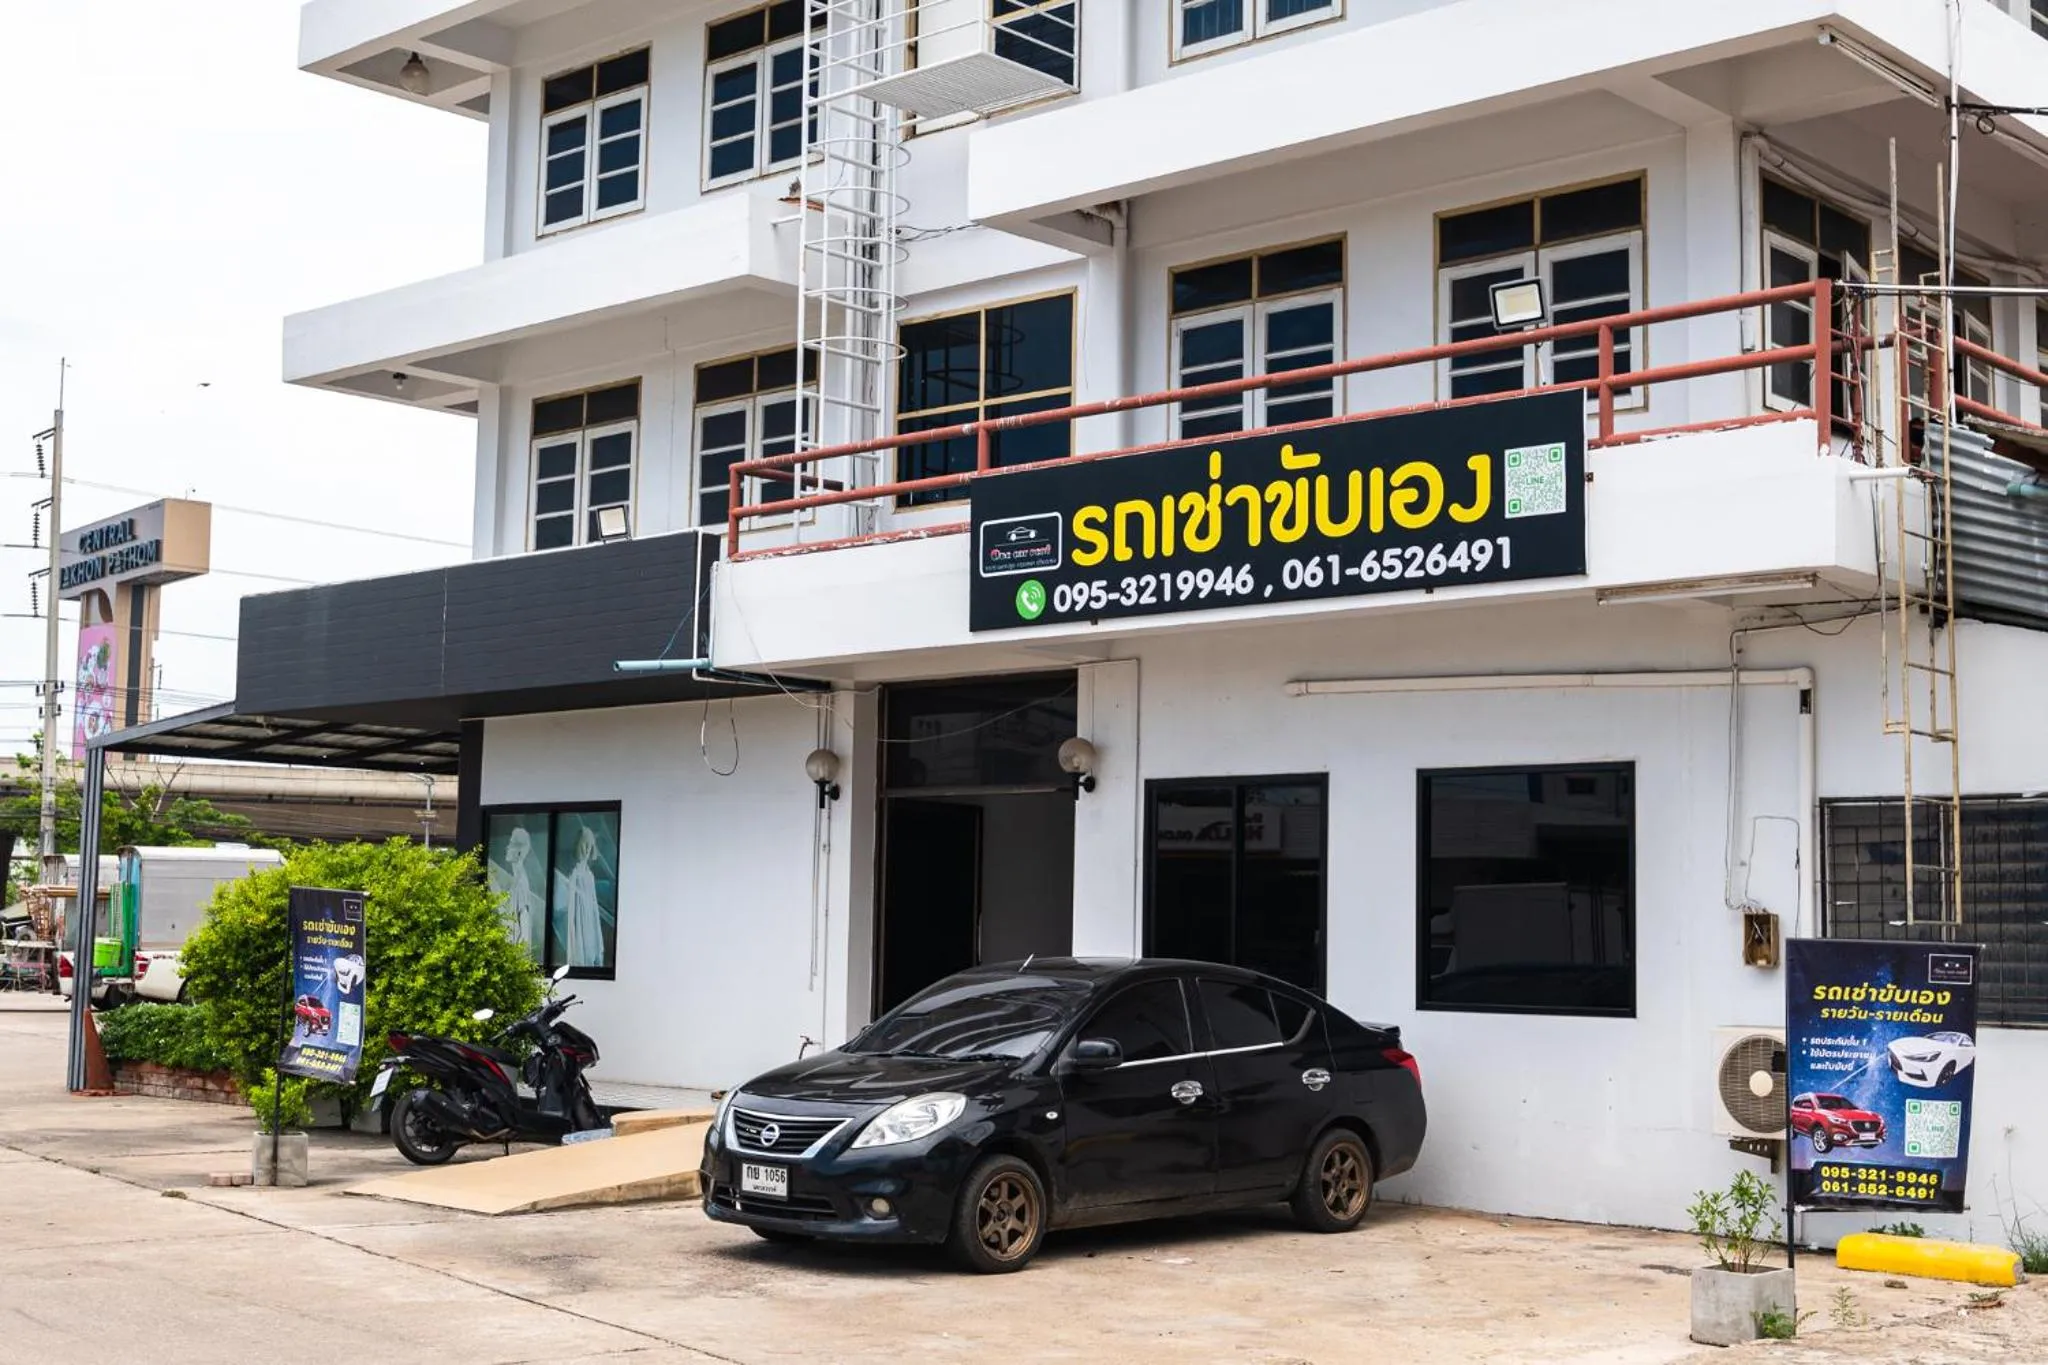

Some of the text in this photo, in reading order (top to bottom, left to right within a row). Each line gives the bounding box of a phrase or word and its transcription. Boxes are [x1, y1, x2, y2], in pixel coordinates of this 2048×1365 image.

[1526, 476, 1545, 485] LINE
[1071, 444, 1493, 567] รถเช่าขับเอง
[79, 518, 137, 555] CENTRAL
[60, 538, 161, 590] AKHON PATHOM
[1052, 562, 1255, 614] 095-3219946
[1282, 536, 1512, 591] 061-6526491
[1812, 983, 1952, 1006] รถเช่าขับเอง
[1820, 1004, 1944, 1024] รายวัน-รายเดือน
[765, 1168, 786, 1184] 1056
[1820, 1165, 1939, 1184] 095-321-9946
[1821, 1180, 1936, 1200] 061-652-6491
